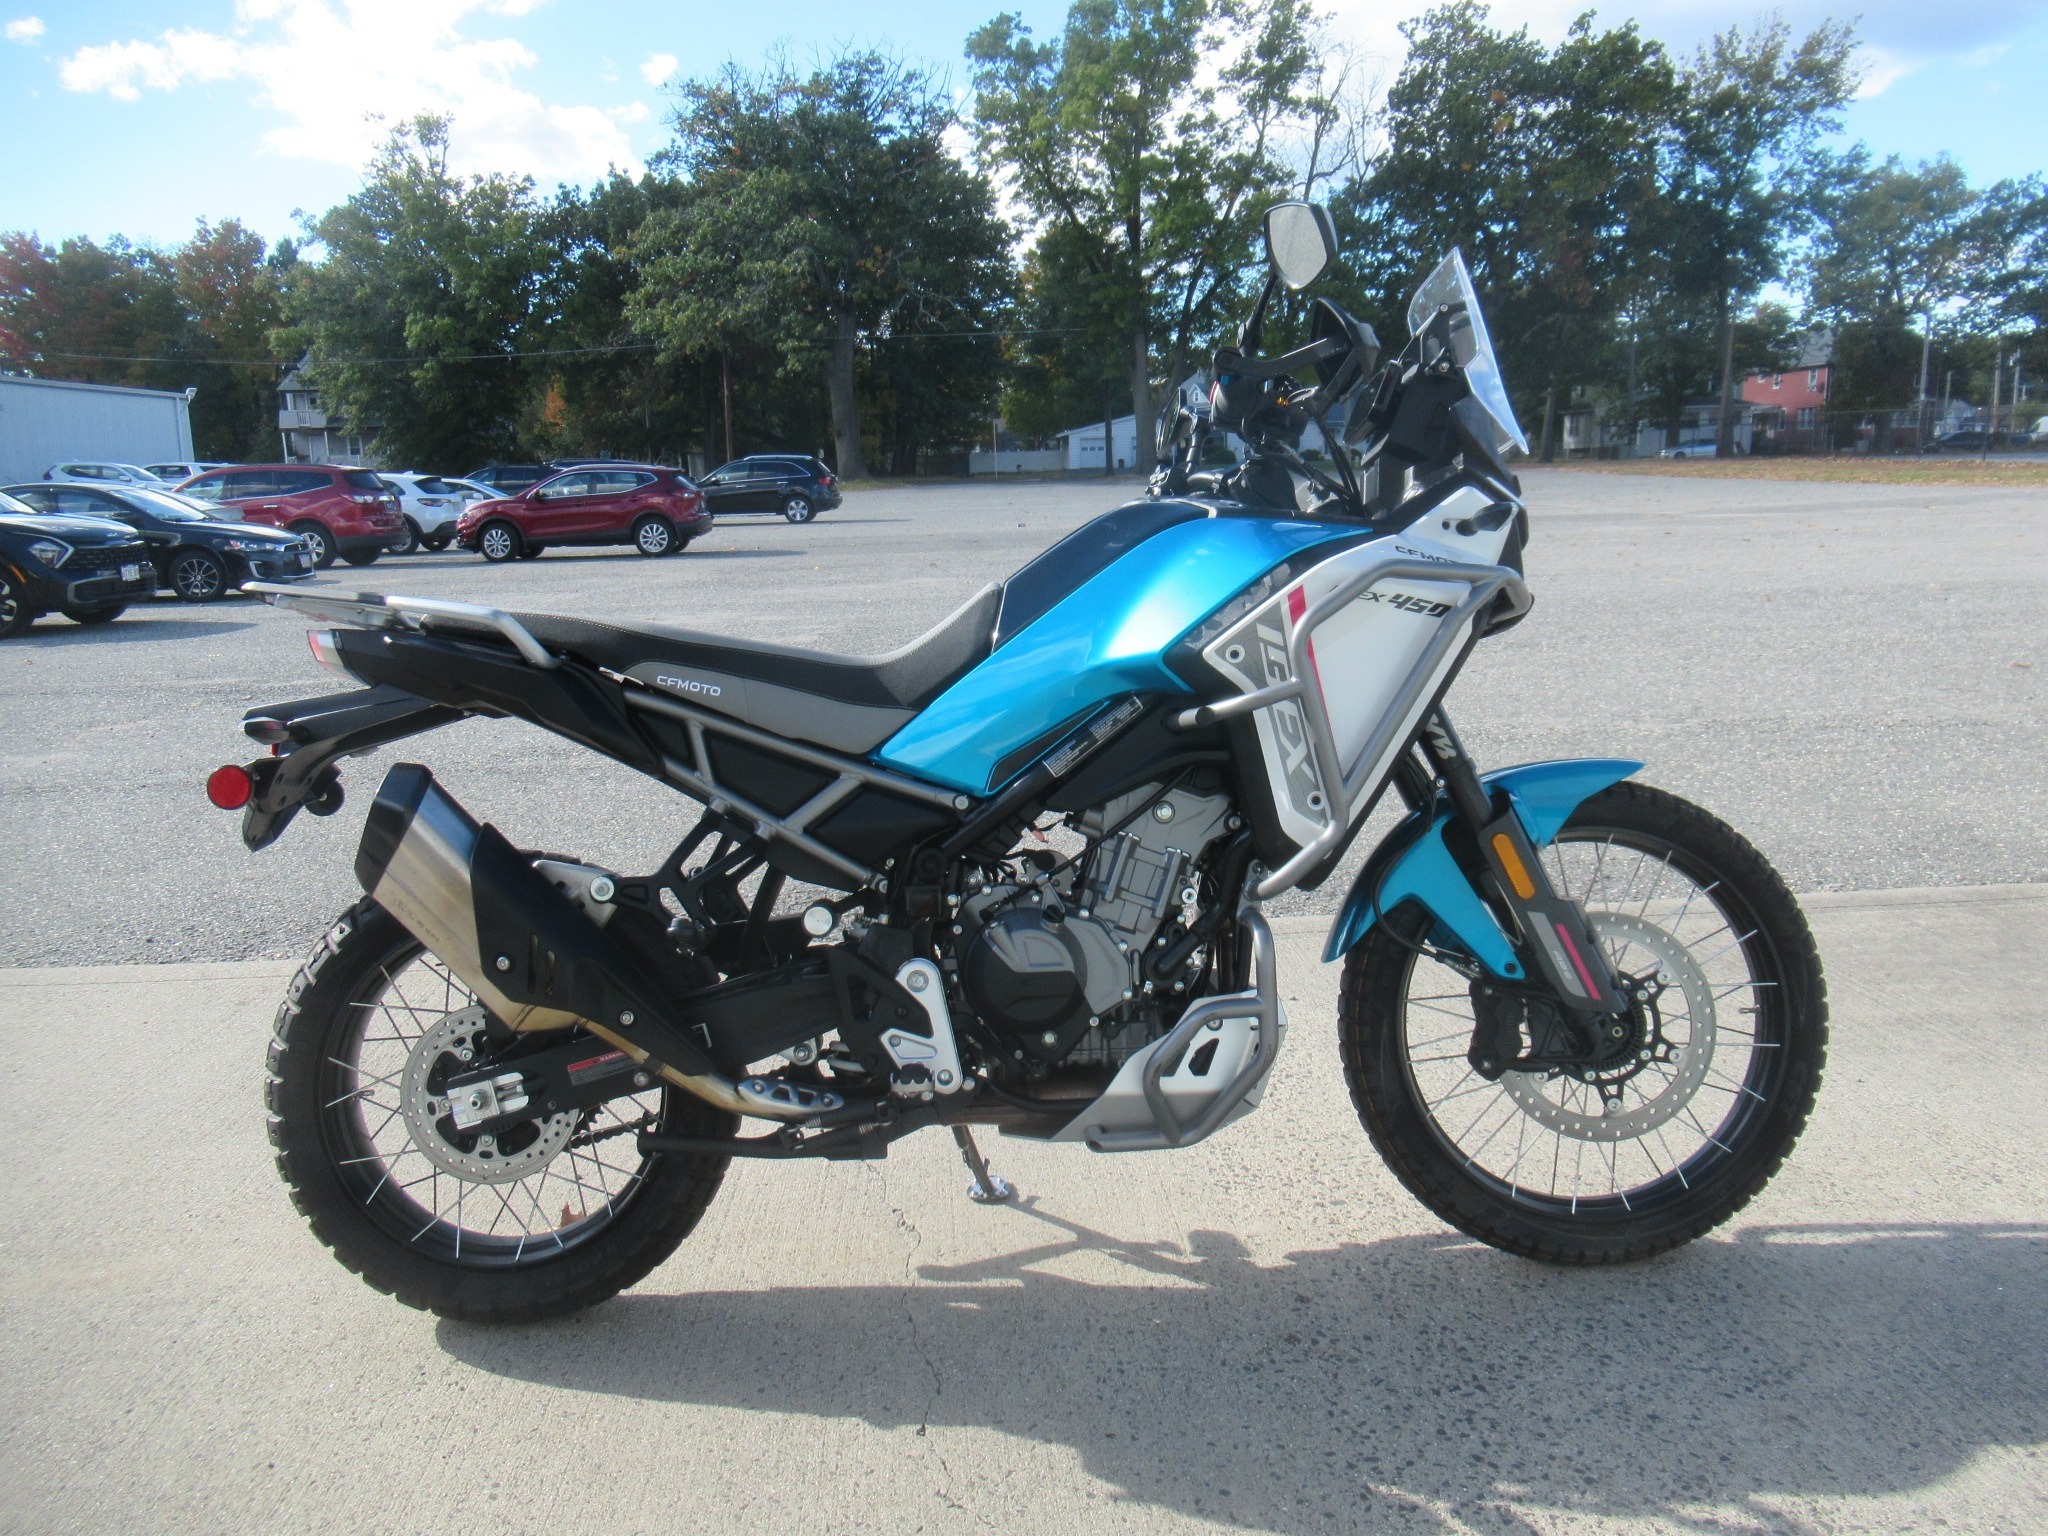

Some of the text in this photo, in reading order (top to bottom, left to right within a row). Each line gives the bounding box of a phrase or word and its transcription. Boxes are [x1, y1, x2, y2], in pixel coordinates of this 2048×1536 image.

[1395, 545, 1458, 563] CFMO
[1387, 593, 1453, 618] 450
[657, 675, 721, 697] CFMOTO
